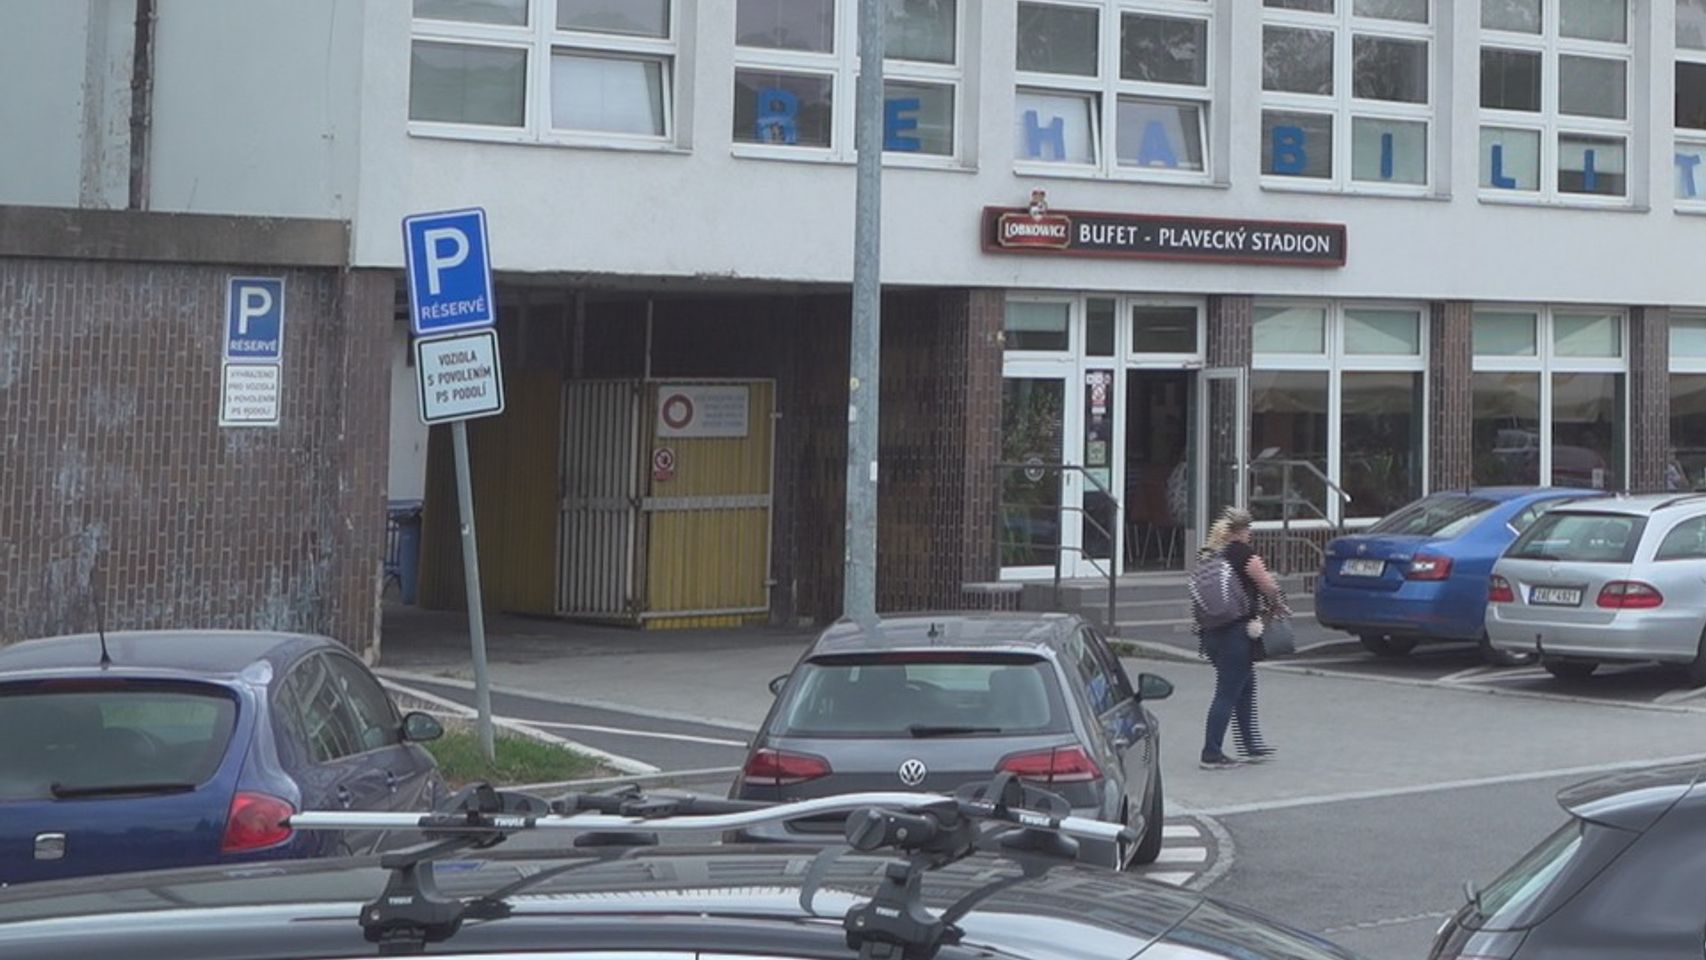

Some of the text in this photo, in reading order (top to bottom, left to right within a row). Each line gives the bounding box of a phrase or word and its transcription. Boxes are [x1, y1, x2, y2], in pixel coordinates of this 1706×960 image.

[1004, 220, 1066, 239] LOBKOWICZ
[1080, 223, 1138, 245] BUFET
[1159, 226, 1248, 249] PLAVECKÝ
[1251, 231, 1331, 253] STADION
[423, 227, 470, 295] P
[238, 287, 273, 335] P
[422, 294, 486, 320] RÉSERVÉ
[229, 338, 277, 352] RÉSERVÉ
[438, 351, 478, 366] VOZIDLA
[428, 366, 492, 387] S POVOLENÍM
[435, 384, 487, 404] PS PODOLÍ
